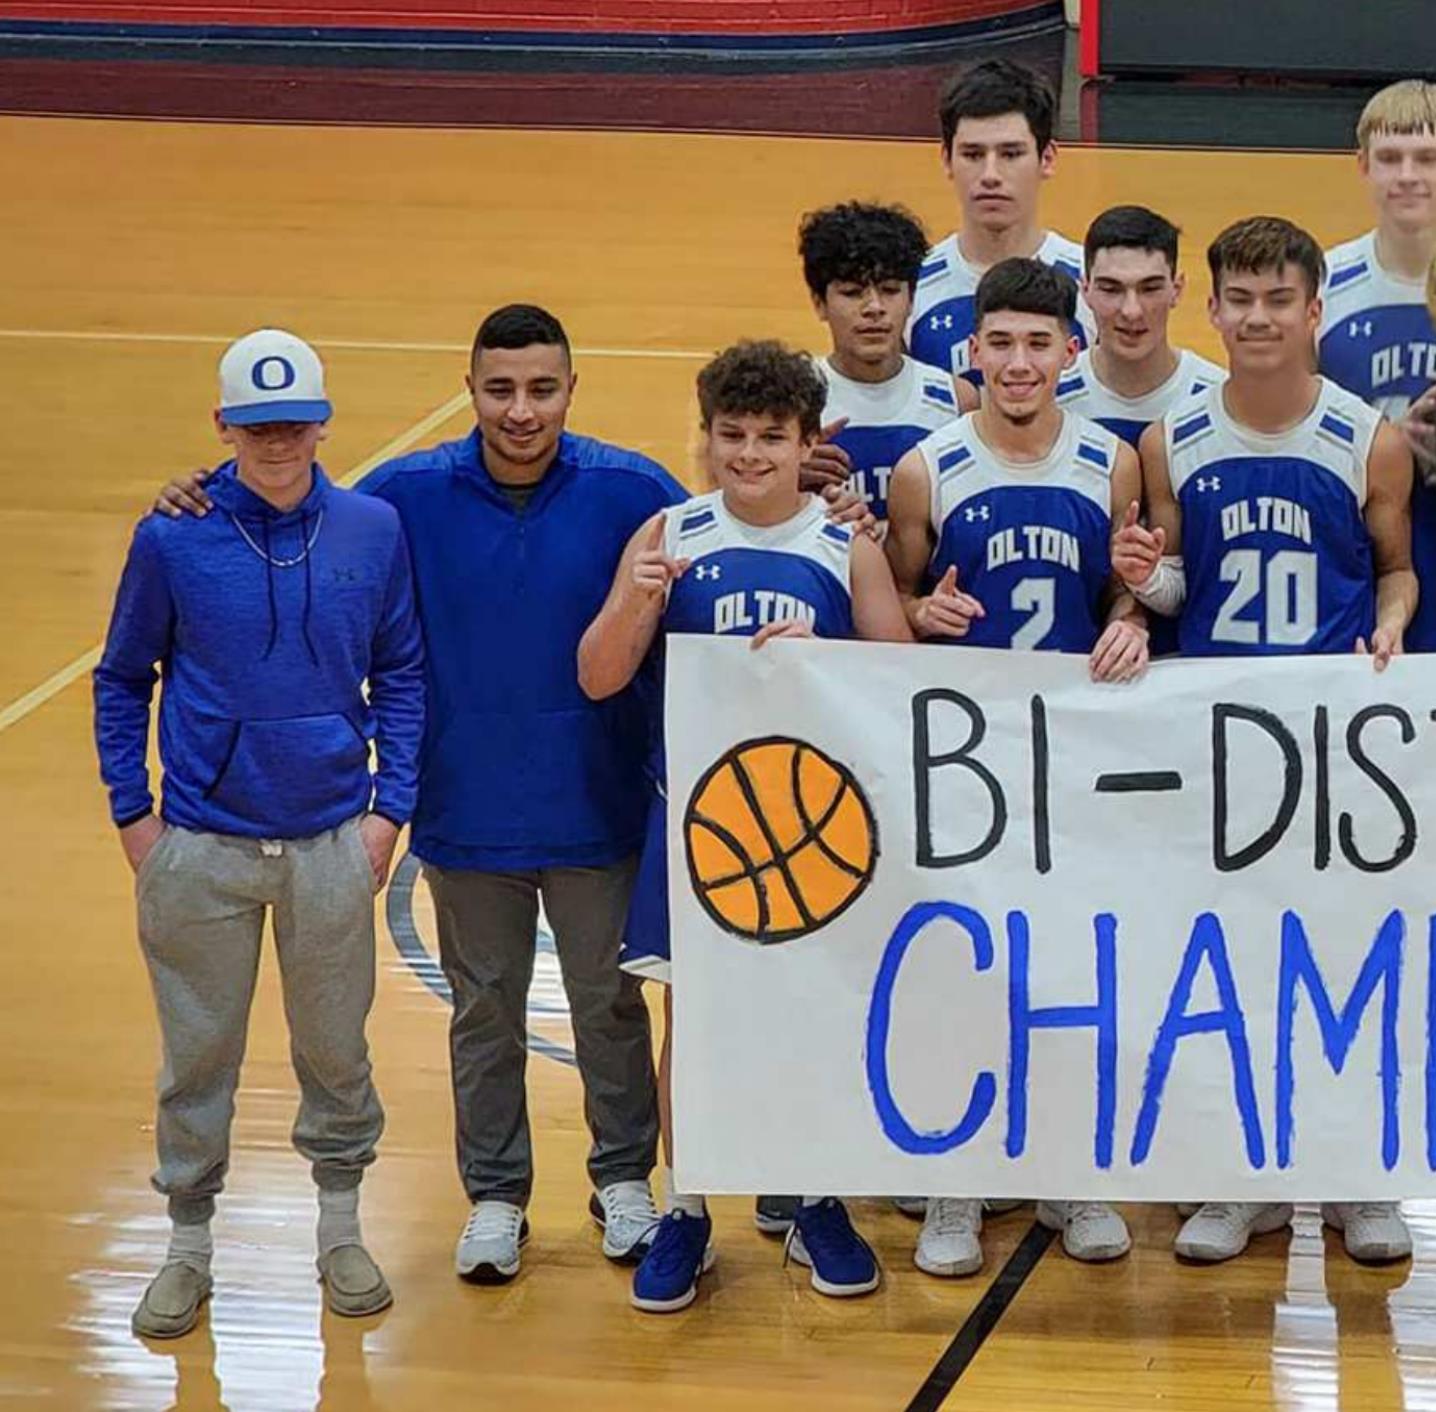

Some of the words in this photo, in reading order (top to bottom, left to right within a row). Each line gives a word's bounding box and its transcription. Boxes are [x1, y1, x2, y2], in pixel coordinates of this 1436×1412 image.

[251, 356, 295, 391] O
[1221, 496, 1312, 545] OLTON
[987, 525, 1079, 573] OLTON
[1010, 577, 1055, 651] 2
[1211, 550, 1318, 645] 20
